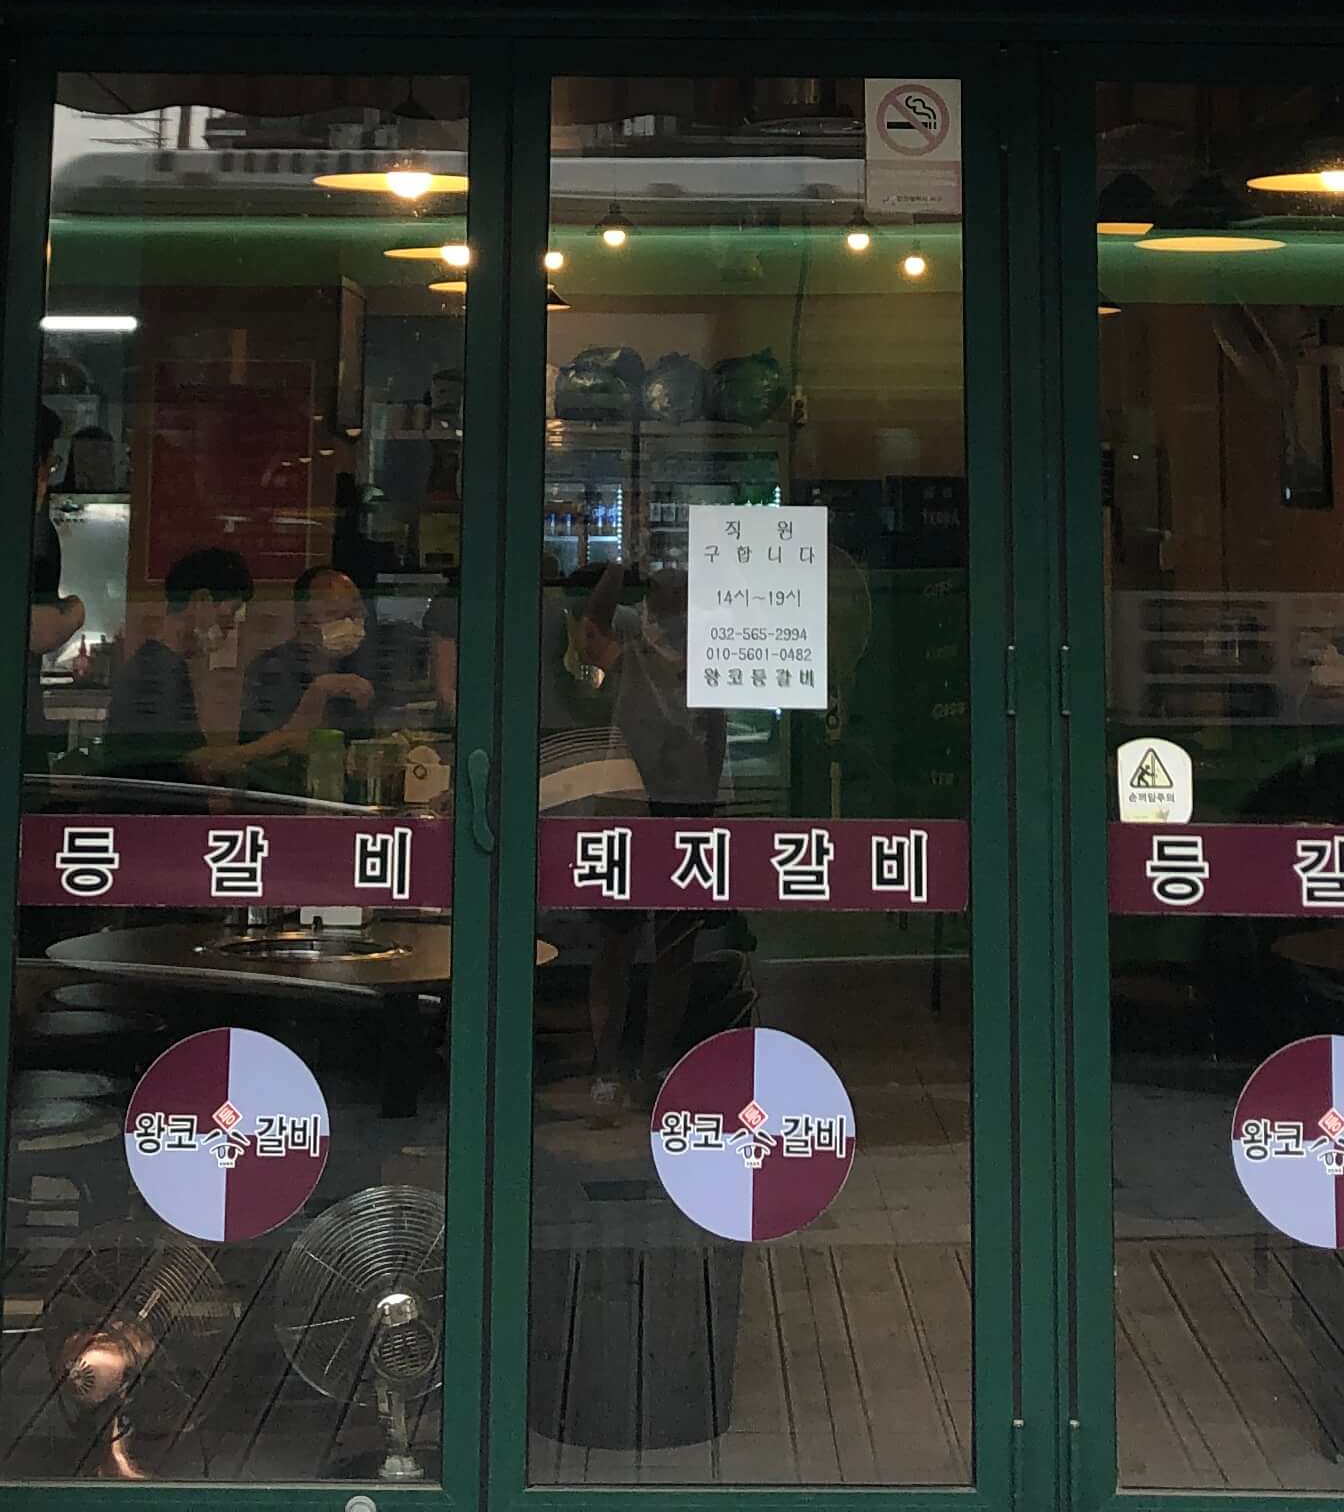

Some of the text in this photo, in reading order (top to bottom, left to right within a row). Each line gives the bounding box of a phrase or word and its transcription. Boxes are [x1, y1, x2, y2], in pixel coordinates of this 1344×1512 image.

[703, 544, 816, 565] 구합니다
[706, 646, 813, 662] 010-5601-0482
[710, 626, 808, 641] 032-565-2994
[573, 826, 930, 903] 돼지갈비
[133, 1111, 199, 1156] 왕코
[255, 1112, 321, 1158] 갈비
[660, 1110, 726, 1155] 왕코
[780, 1114, 847, 1159] 갈비
[1240, 1118, 1307, 1163] 왕코
